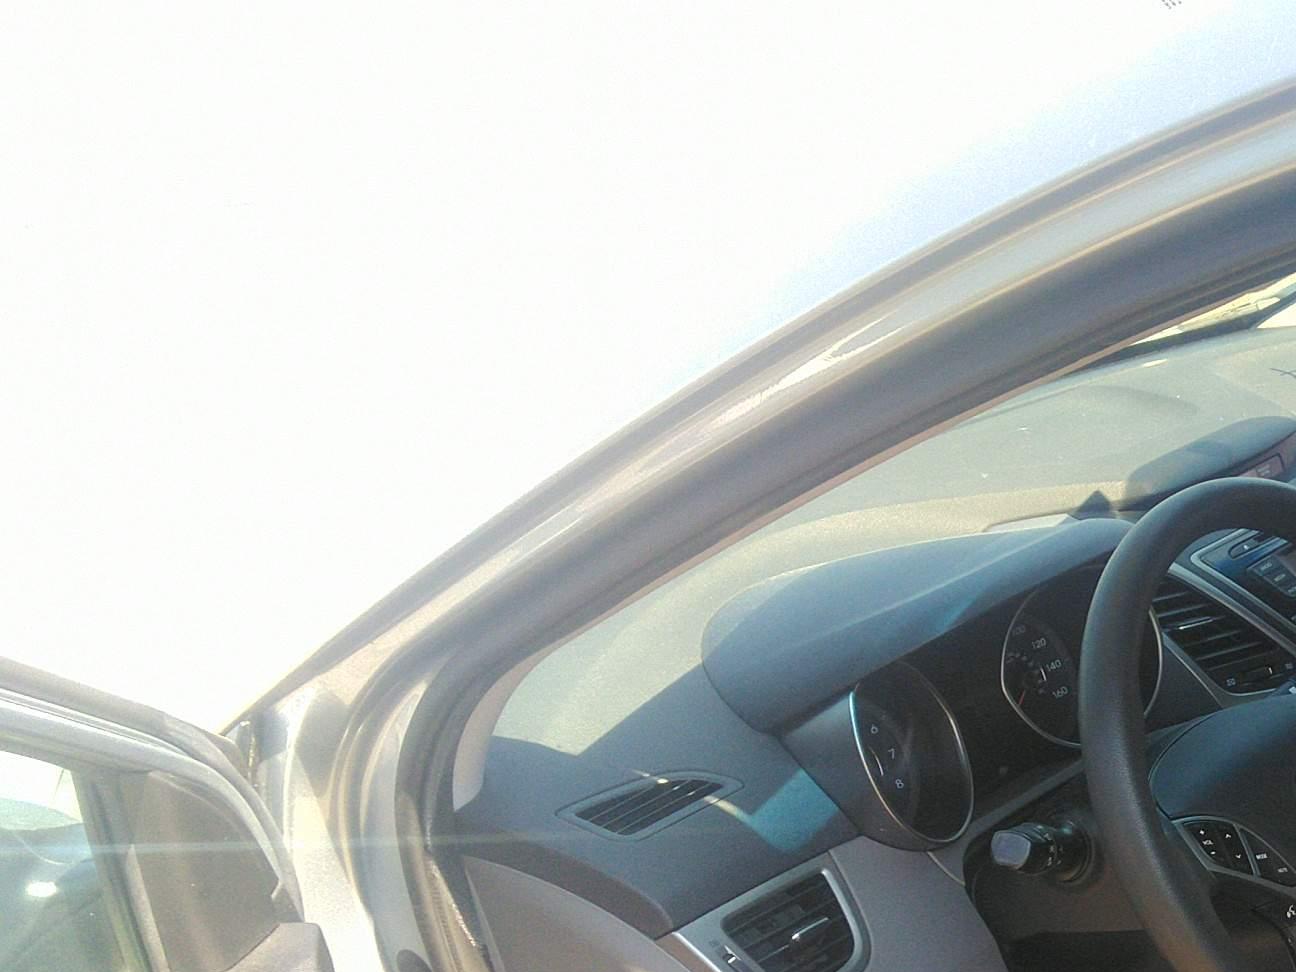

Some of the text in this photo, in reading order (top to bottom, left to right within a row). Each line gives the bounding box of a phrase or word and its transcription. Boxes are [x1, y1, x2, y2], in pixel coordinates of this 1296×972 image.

[1031, 637, 1047, 649] 120
[1046, 659, 1062, 672] 140
[1052, 686, 1069, 699] 160
[870, 723, 879, 734] 6
[887, 748, 896, 760] 7
[895, 778, 905, 789] 8
